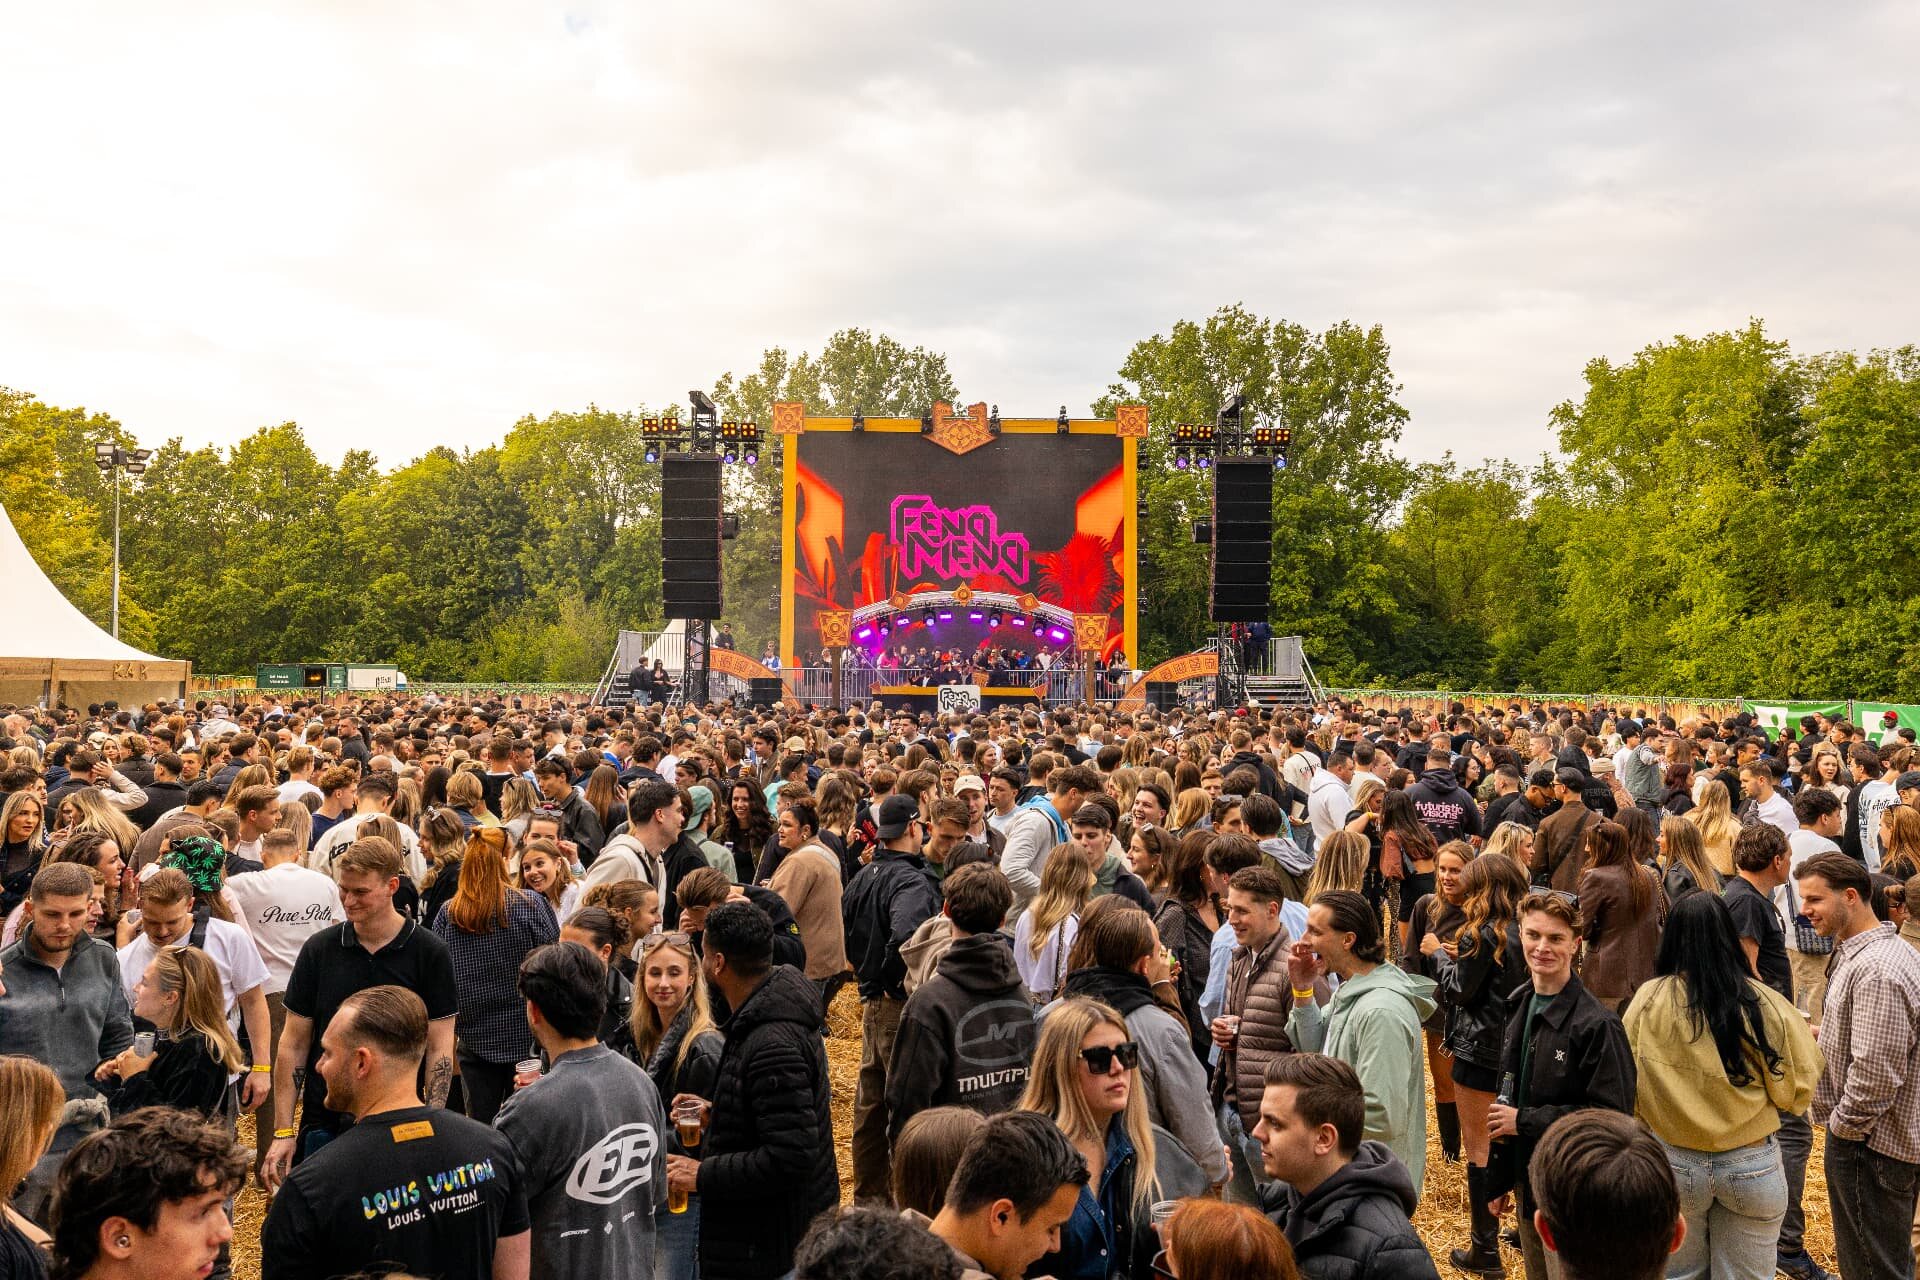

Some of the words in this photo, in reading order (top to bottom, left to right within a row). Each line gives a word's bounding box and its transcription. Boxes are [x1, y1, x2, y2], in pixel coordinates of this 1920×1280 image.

[890, 494, 998, 547] FENO
[900, 532, 1030, 585] MENO
[1415, 801, 1463, 814] futuristic
[1423, 810, 1458, 819] visions
[259, 905, 300, 924] Pure
[301, 903, 332, 921] Path
[361, 1180, 421, 1220] LOUIS
[427, 1158, 496, 1196] VUITTON
[429, 1189, 479, 1213] VUITTON
